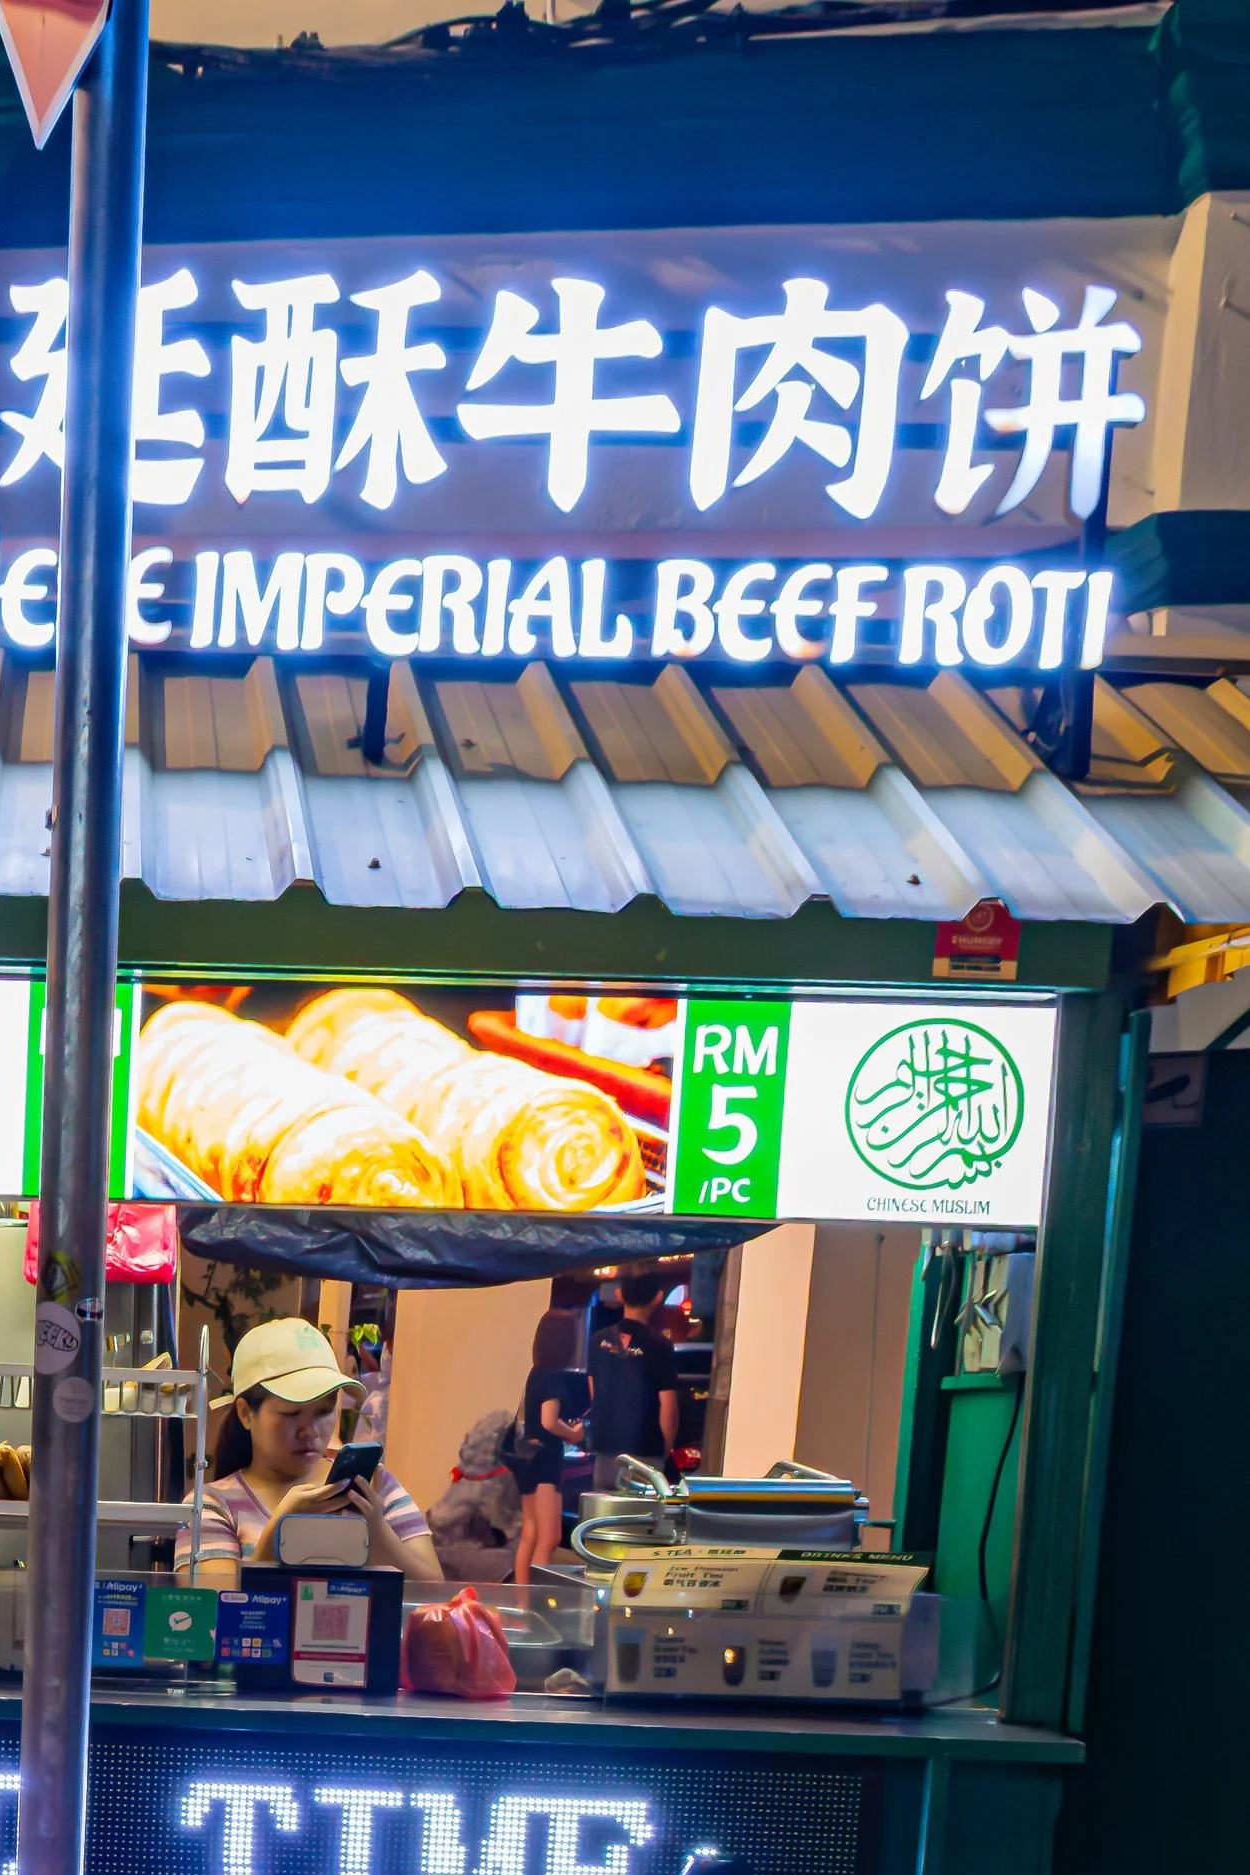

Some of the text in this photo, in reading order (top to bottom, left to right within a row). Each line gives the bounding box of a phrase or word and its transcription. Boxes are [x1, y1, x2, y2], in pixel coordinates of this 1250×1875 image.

[189, 550, 633, 662] IMPERIAL
[651, 558, 889, 664] BEEF
[898, 565, 1114, 671] ROTI
[693, 1024, 779, 1077] RM
[701, 1084, 758, 1166] 5
[698, 1176, 751, 1205] /PC
[866, 1196, 991, 1216] CHINESE MUSLIM
[868, 1553, 914, 1561] MENU
